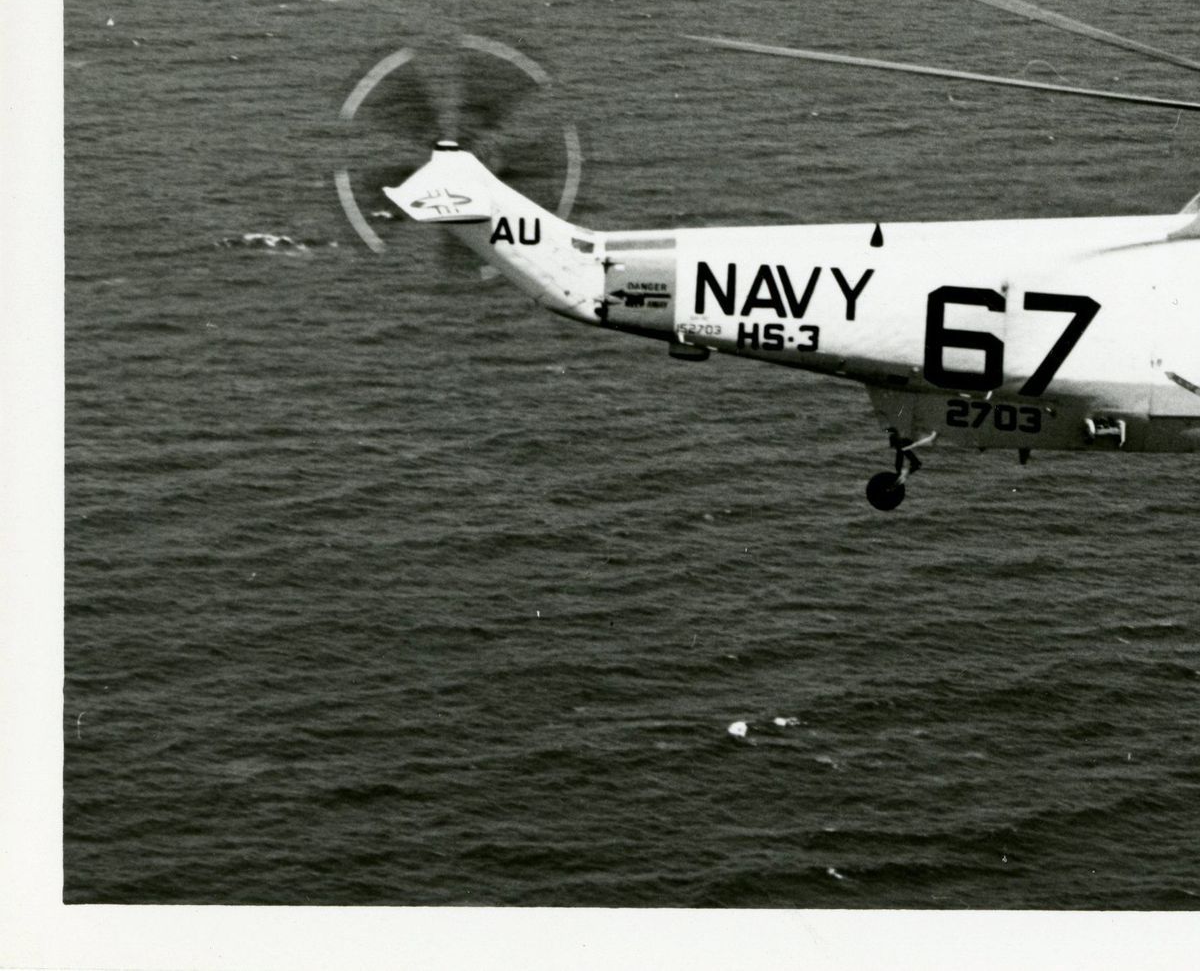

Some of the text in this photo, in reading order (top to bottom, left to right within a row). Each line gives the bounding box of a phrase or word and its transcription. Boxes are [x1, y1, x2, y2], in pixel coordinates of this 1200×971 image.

[490, 216, 541, 245] AU
[695, 262, 875, 321] NAVY
[924, 285, 1101, 396] 67
[946, 399, 1042, 433] 2703
